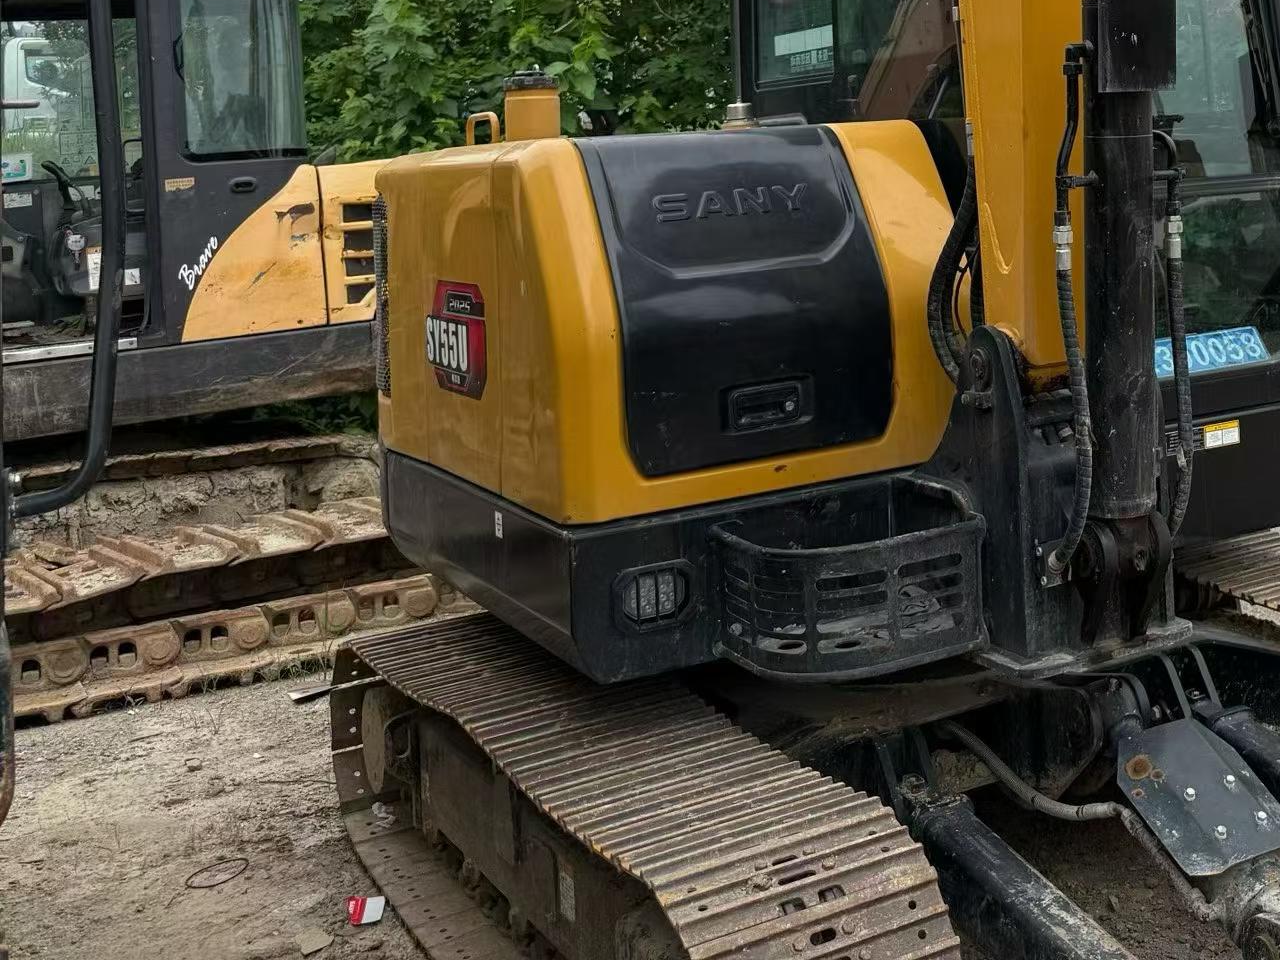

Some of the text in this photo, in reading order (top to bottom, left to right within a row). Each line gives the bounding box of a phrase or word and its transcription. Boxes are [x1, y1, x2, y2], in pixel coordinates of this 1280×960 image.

[652, 183, 808, 224] SANY
[178, 236, 219, 291] Brave
[426, 316, 468, 372] SY55U
